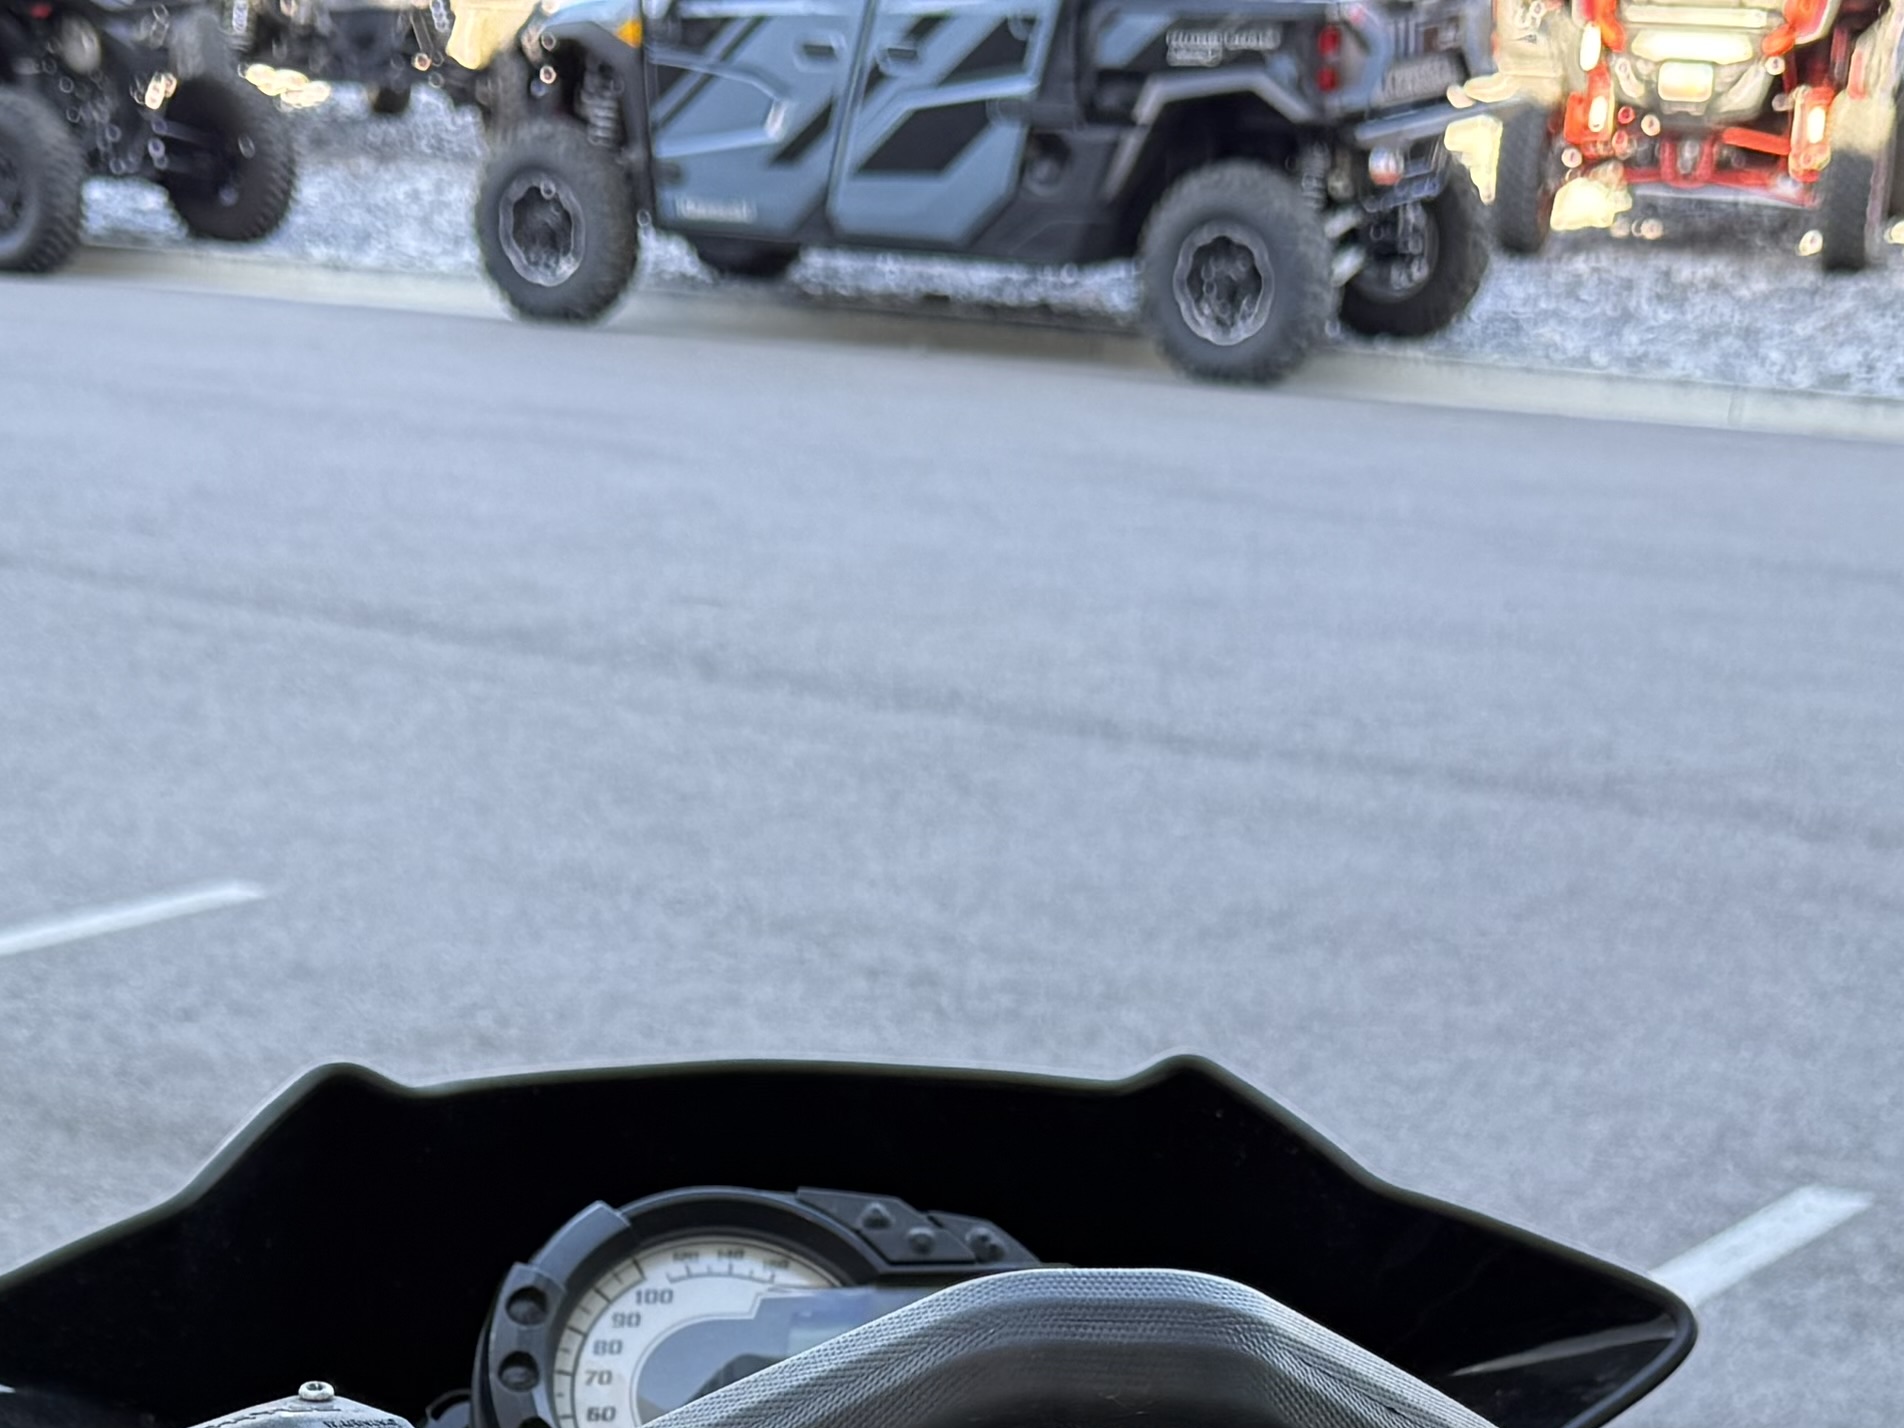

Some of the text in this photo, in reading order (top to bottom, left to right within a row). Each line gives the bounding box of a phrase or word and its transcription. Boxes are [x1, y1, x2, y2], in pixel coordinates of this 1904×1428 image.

[635, 1288, 674, 1305] 100
[610, 1312, 641, 1329] 90
[592, 1339, 622, 1356] 80
[585, 1370, 612, 1387] 70
[586, 1406, 616, 1423] 60
